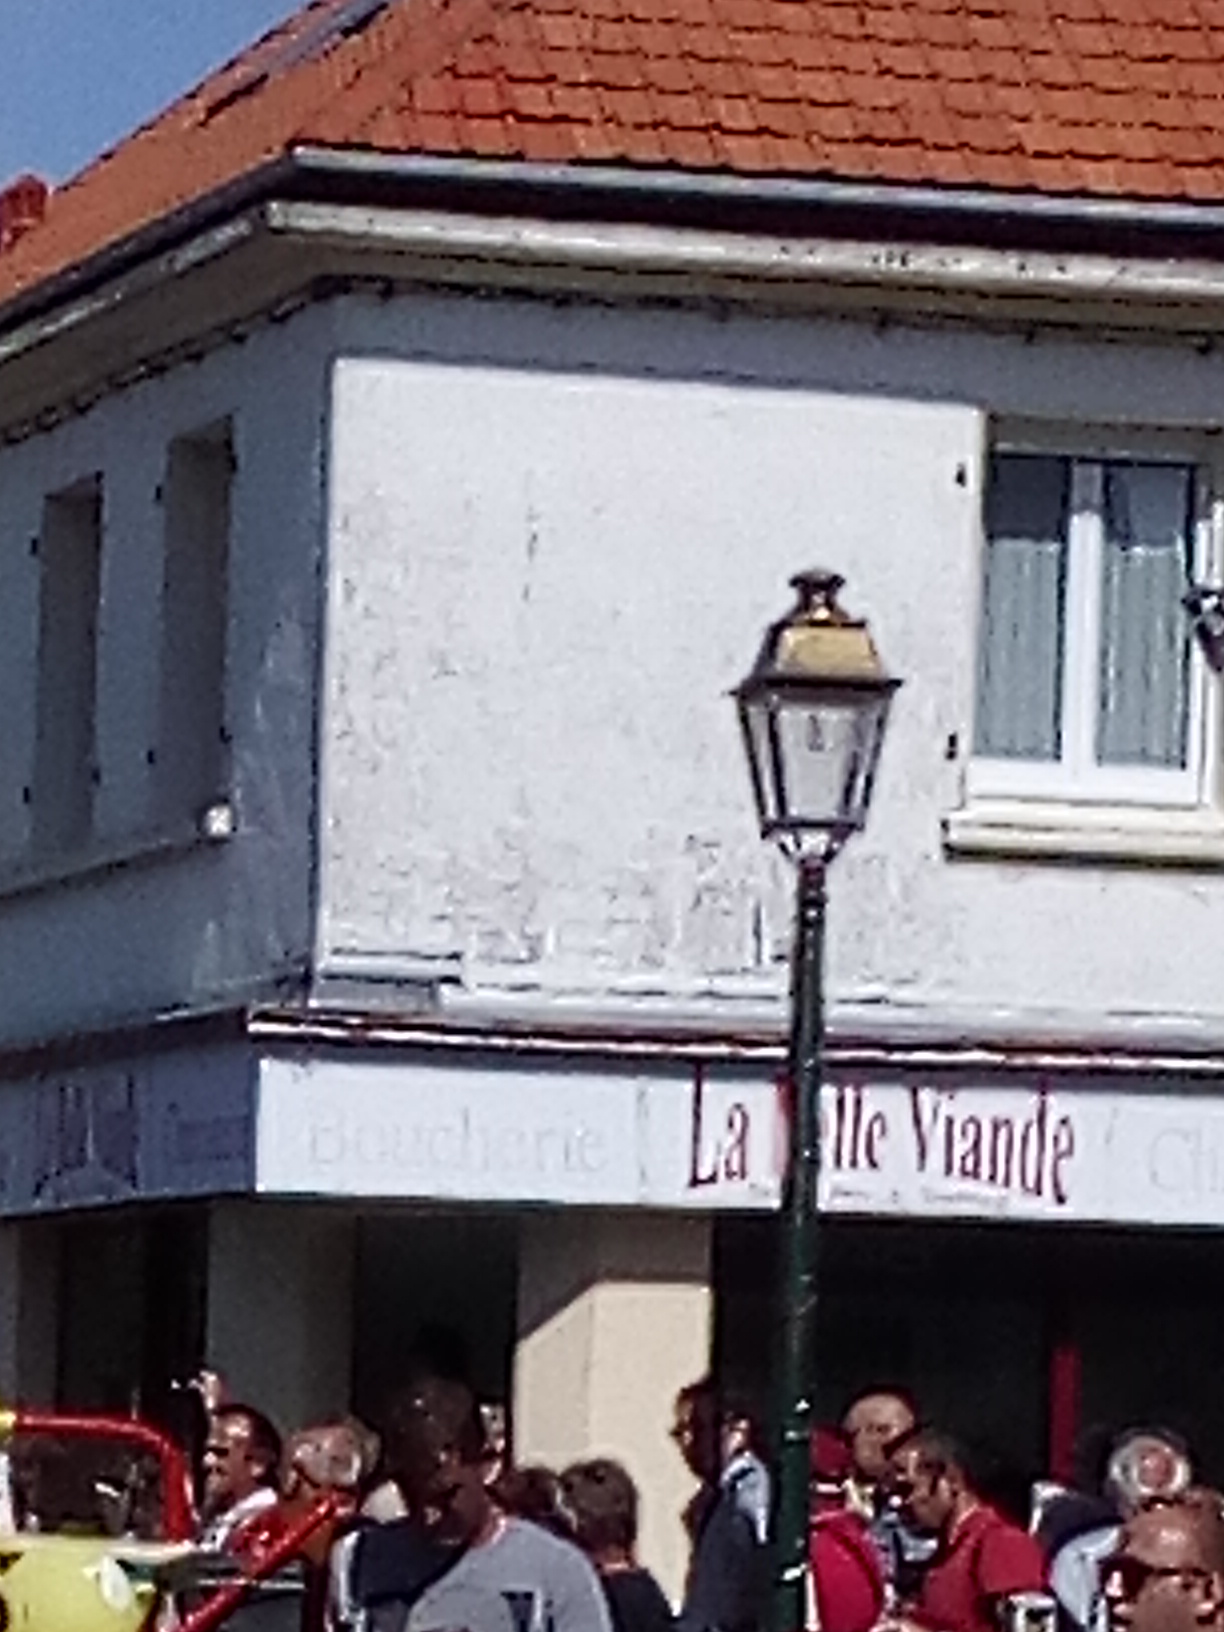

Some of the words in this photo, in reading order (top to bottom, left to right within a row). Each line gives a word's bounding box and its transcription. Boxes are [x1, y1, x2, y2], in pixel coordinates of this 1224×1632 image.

[689, 1066, 749, 1189] La
[775, 1072, 886, 1178] lle
[912, 1075, 1076, 1206] Viande
